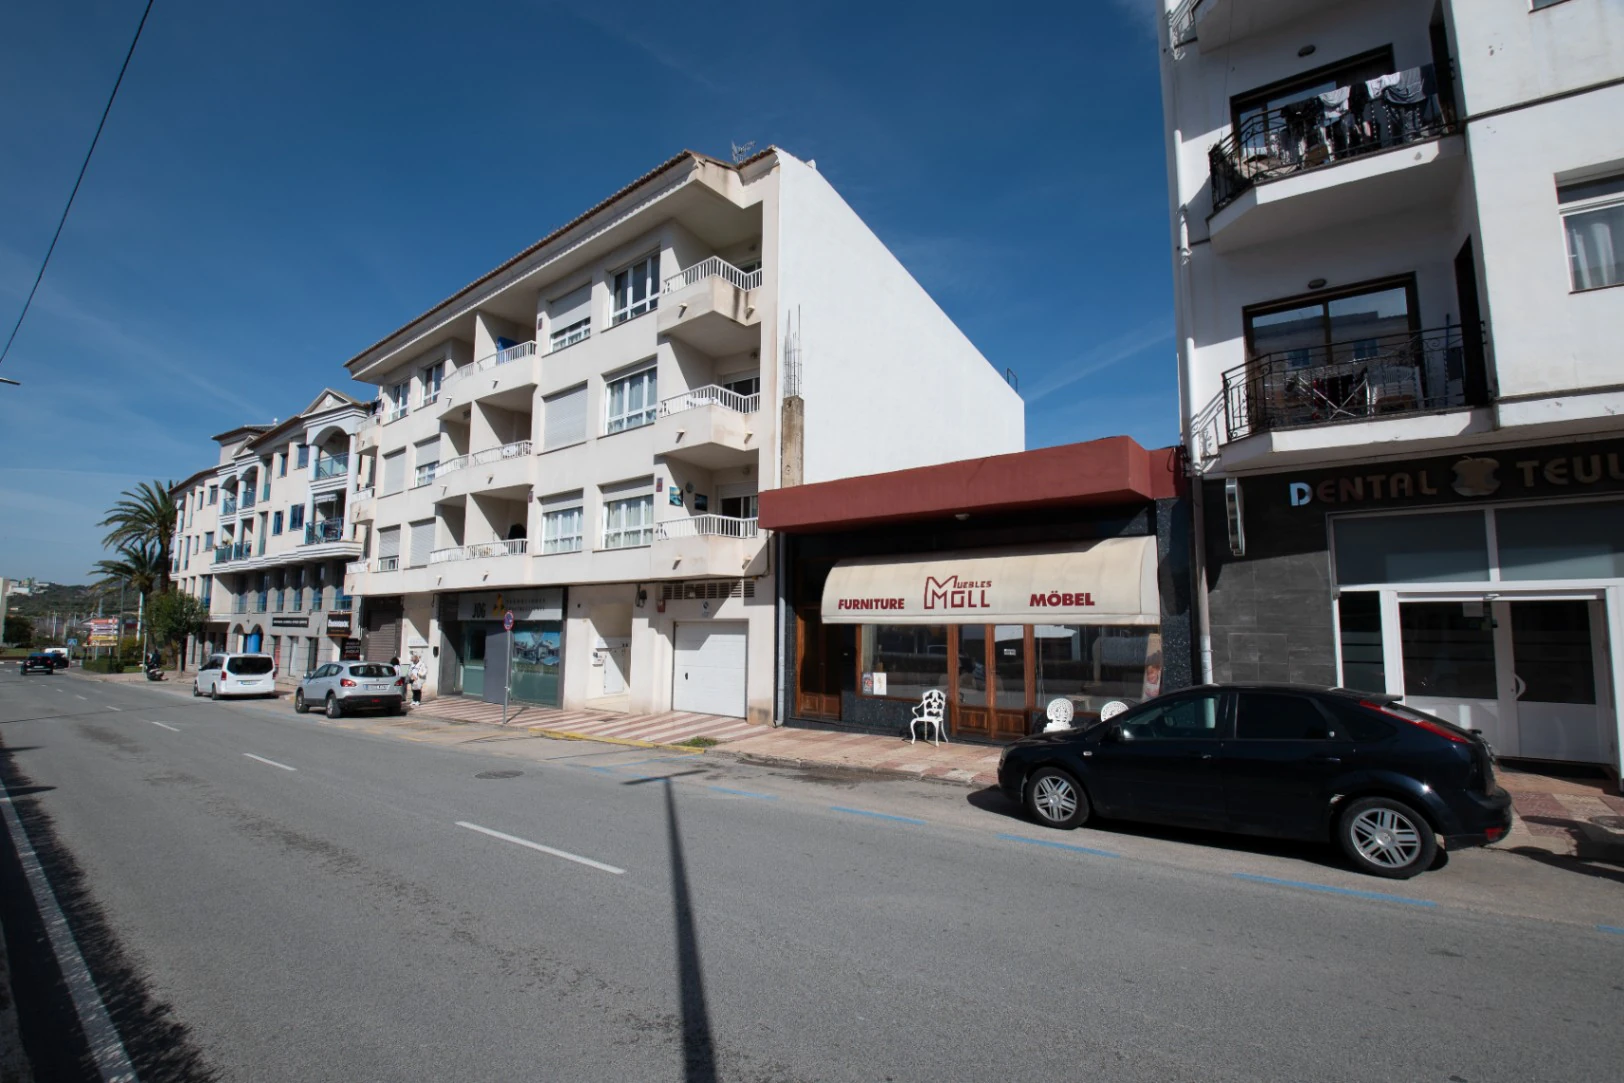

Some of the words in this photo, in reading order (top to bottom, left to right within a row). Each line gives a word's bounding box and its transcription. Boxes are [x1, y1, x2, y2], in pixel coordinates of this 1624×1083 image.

[1289, 470, 1437, 506] DENTAL
[924, 575, 992, 590] MUEBLES
[838, 598, 905, 610] FURNITURE
[1029, 590, 1095, 607] MÖBEL
